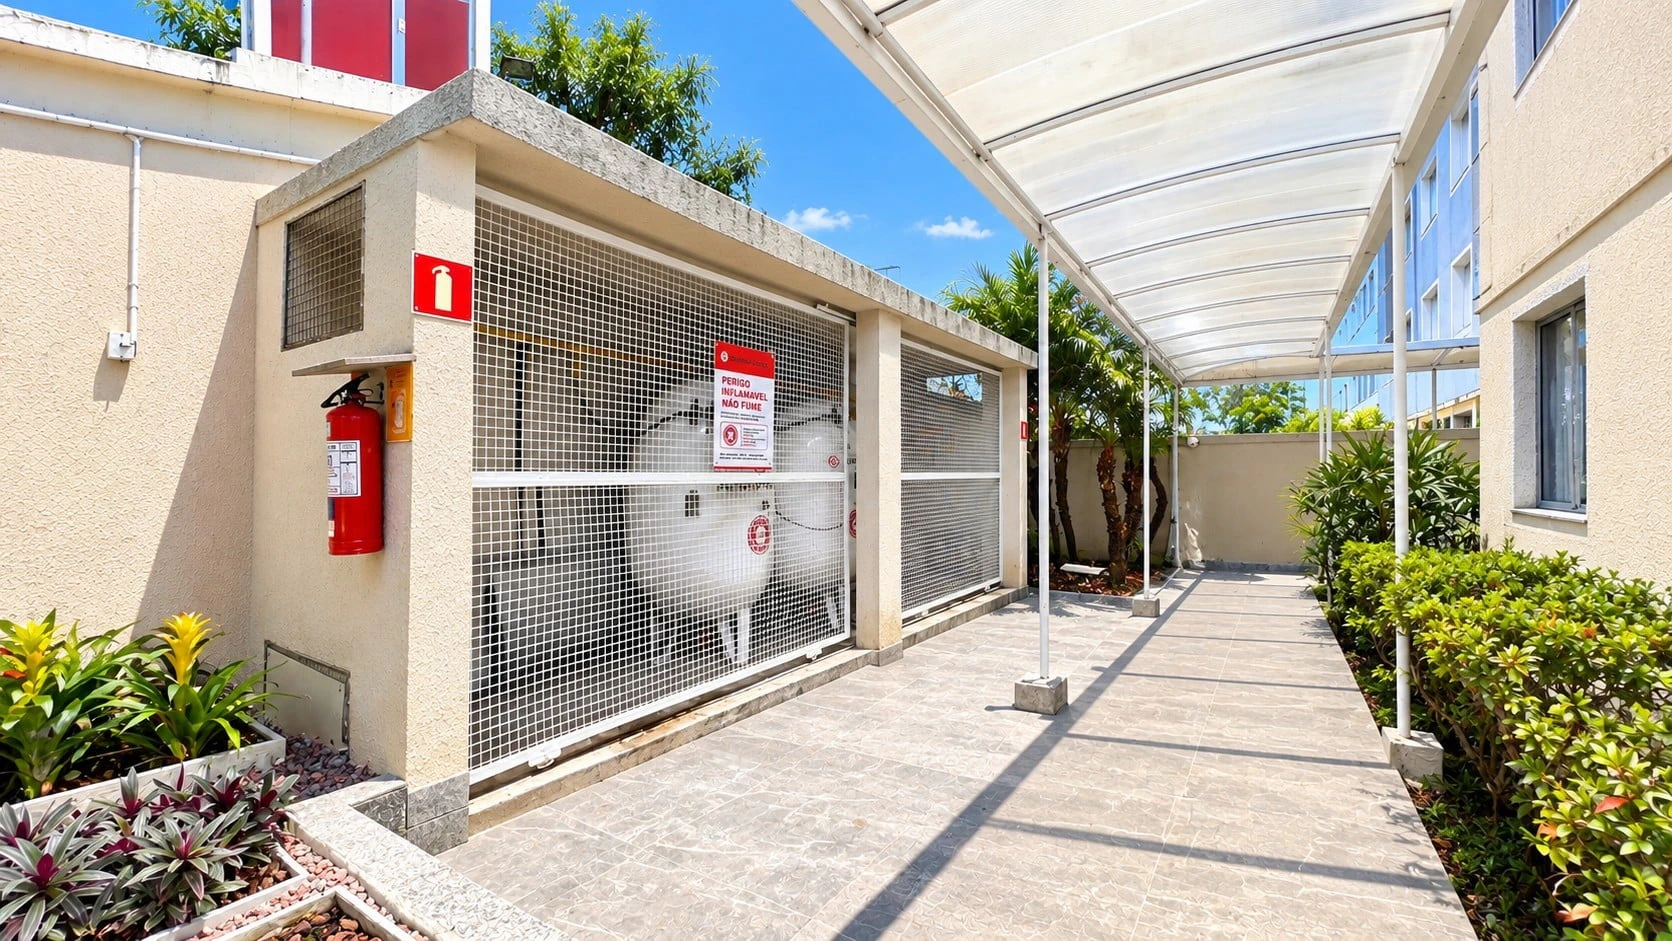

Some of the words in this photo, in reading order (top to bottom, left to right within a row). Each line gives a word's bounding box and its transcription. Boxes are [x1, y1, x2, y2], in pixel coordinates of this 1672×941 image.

[721, 376, 750, 388] PERIGO
[721, 387, 768, 402] INFLAMAVEL
[741, 401, 762, 411] FUME
